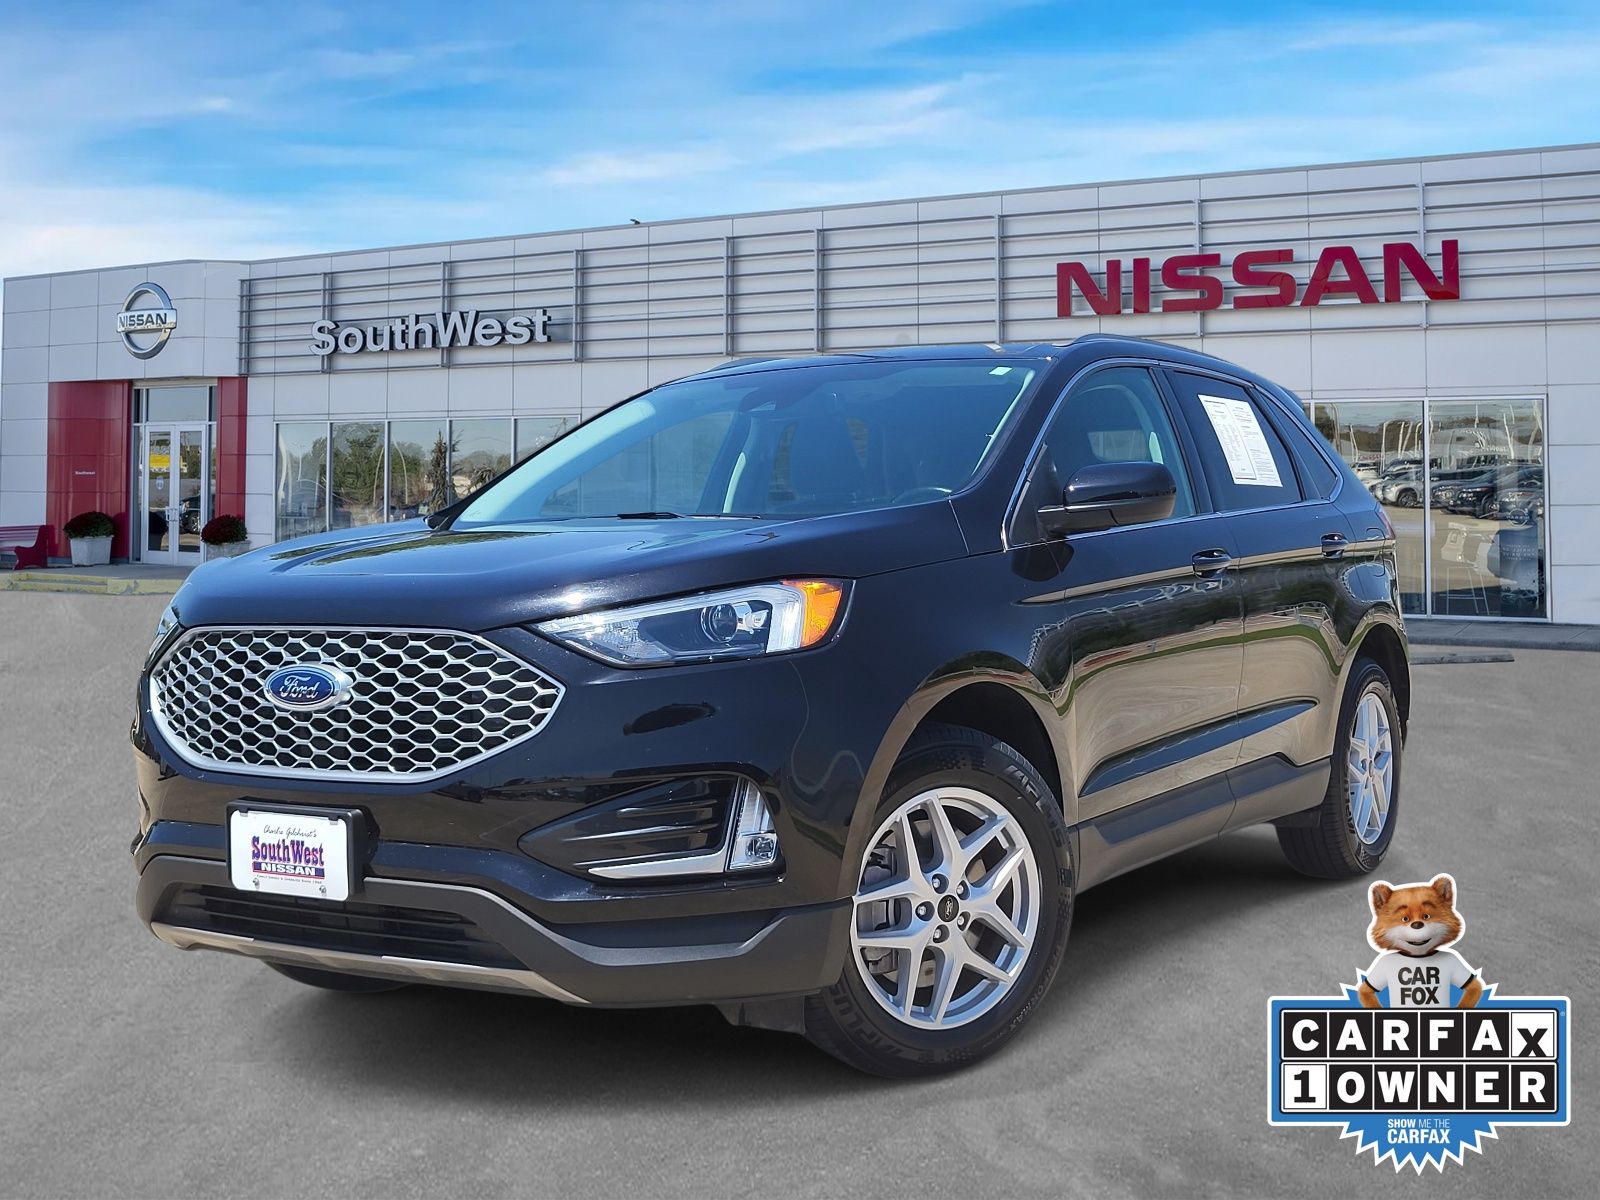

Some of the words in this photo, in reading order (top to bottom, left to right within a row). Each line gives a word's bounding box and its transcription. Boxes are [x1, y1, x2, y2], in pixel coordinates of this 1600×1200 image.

[1057, 239, 1461, 317] NISSAN
[119, 312, 168, 328] NISSAN
[309, 308, 552, 356] SouthWest
[279, 675, 322, 699] Ford
[251, 835, 325, 867] SouthWest
[260, 861, 316, 877] NISSAN
